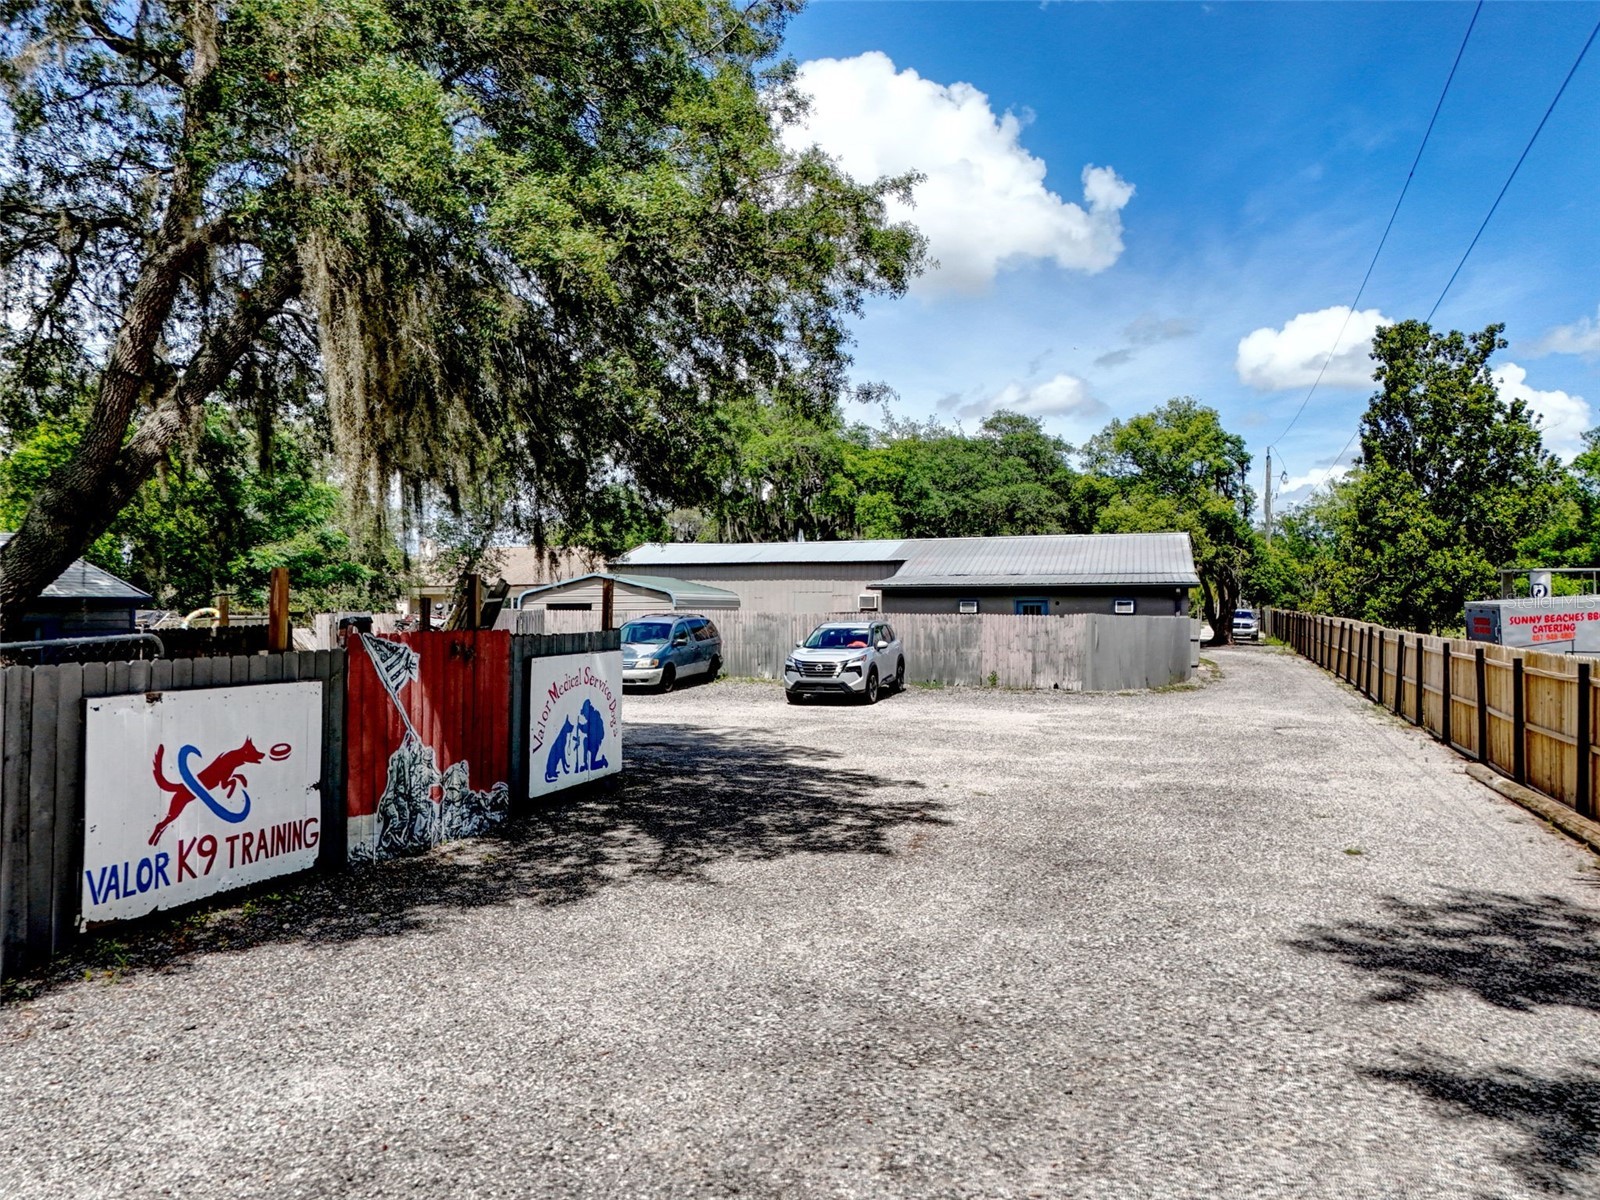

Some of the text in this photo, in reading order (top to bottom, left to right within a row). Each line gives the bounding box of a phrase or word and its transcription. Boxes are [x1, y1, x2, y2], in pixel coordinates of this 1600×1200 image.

[1510, 612, 1600, 625] SUNNY BEACHES BB
[1532, 623, 1576, 634] CATERING
[532, 700, 552, 754] Valor
[548, 668, 582, 704] Medical
[584, 666, 612, 700] Service
[86, 817, 319, 905] VALOR K9 TRAINING
